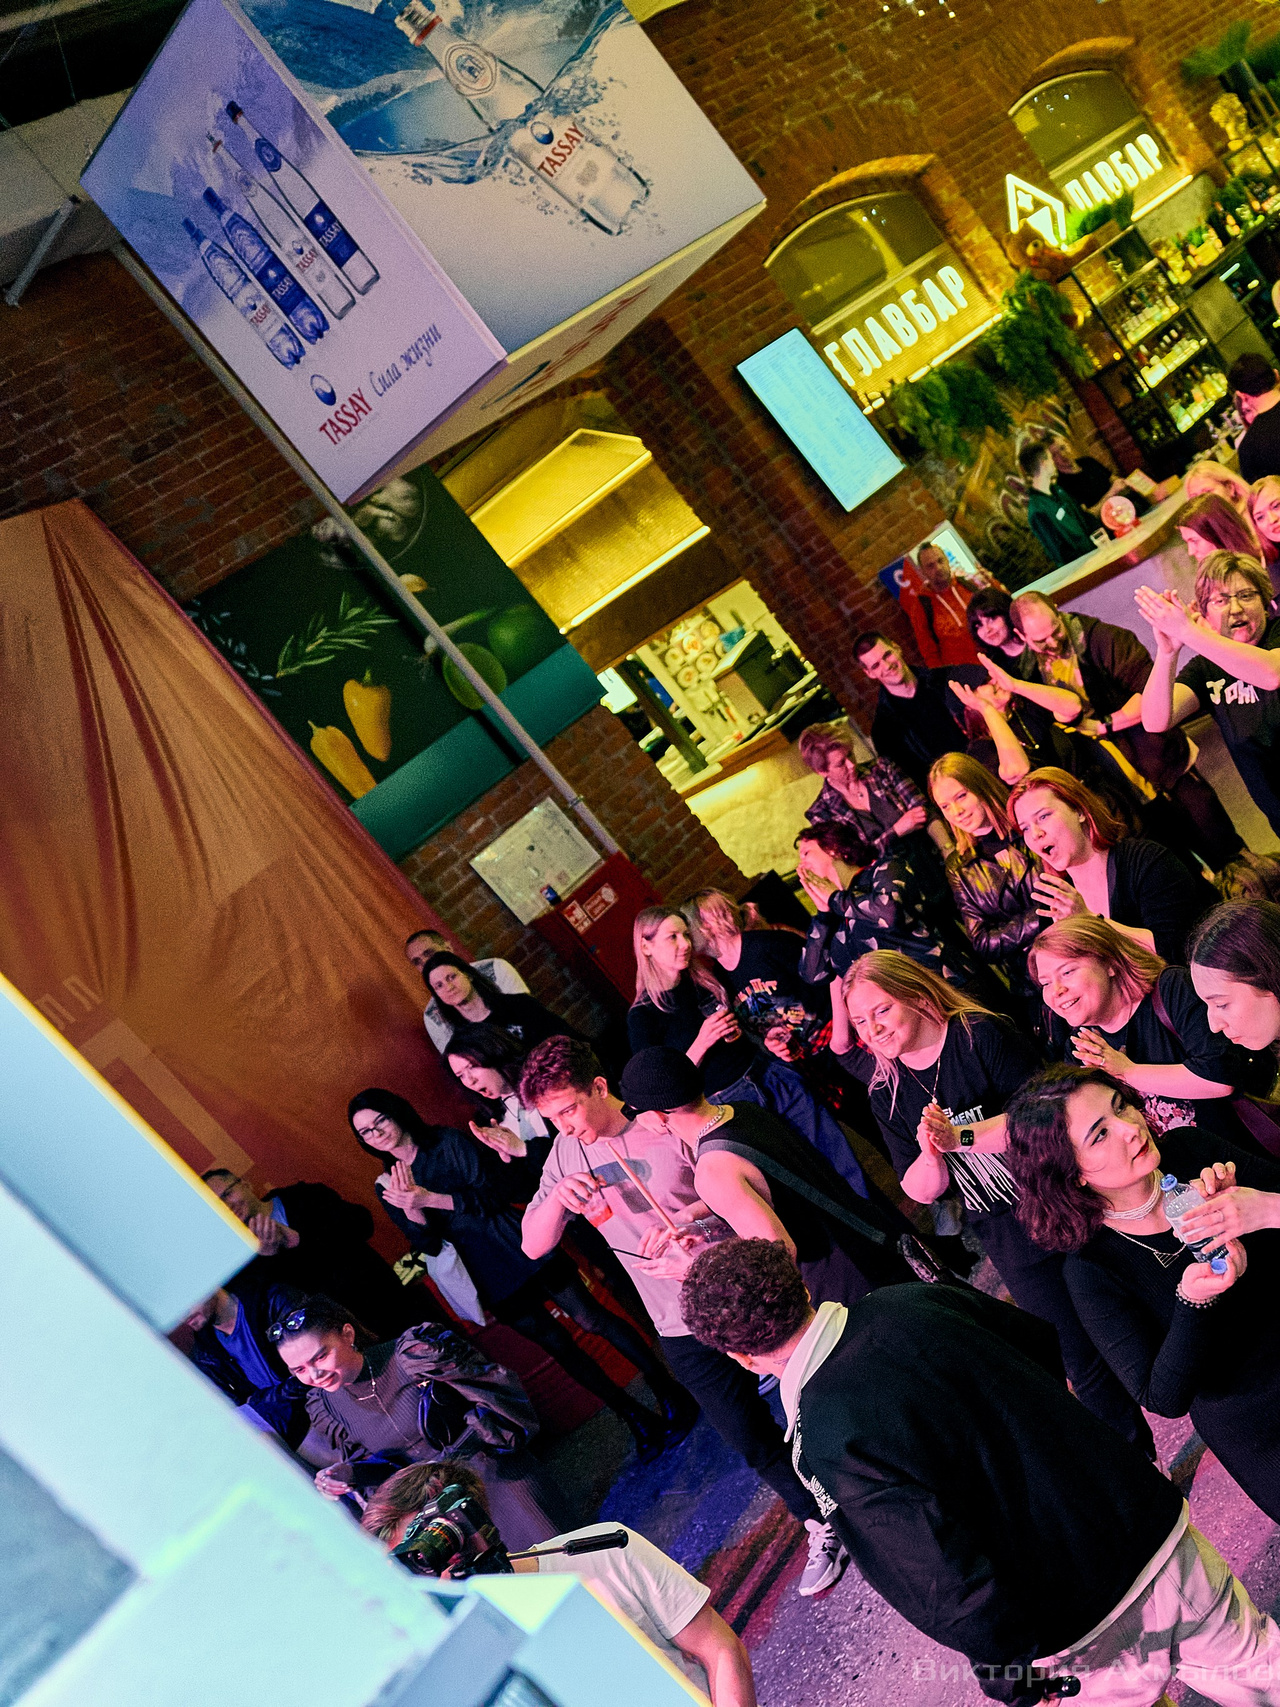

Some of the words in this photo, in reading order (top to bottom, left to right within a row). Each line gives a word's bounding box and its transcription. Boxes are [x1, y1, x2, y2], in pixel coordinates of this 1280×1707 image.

[537, 122, 584, 177] TASSAY
[823, 265, 968, 387] ГЛАВБАР
[369, 363, 402, 397] Сила
[400, 324, 442, 370] жизни
[320, 387, 372, 445] TASSAY
[950, 1105, 982, 1126] MENT
